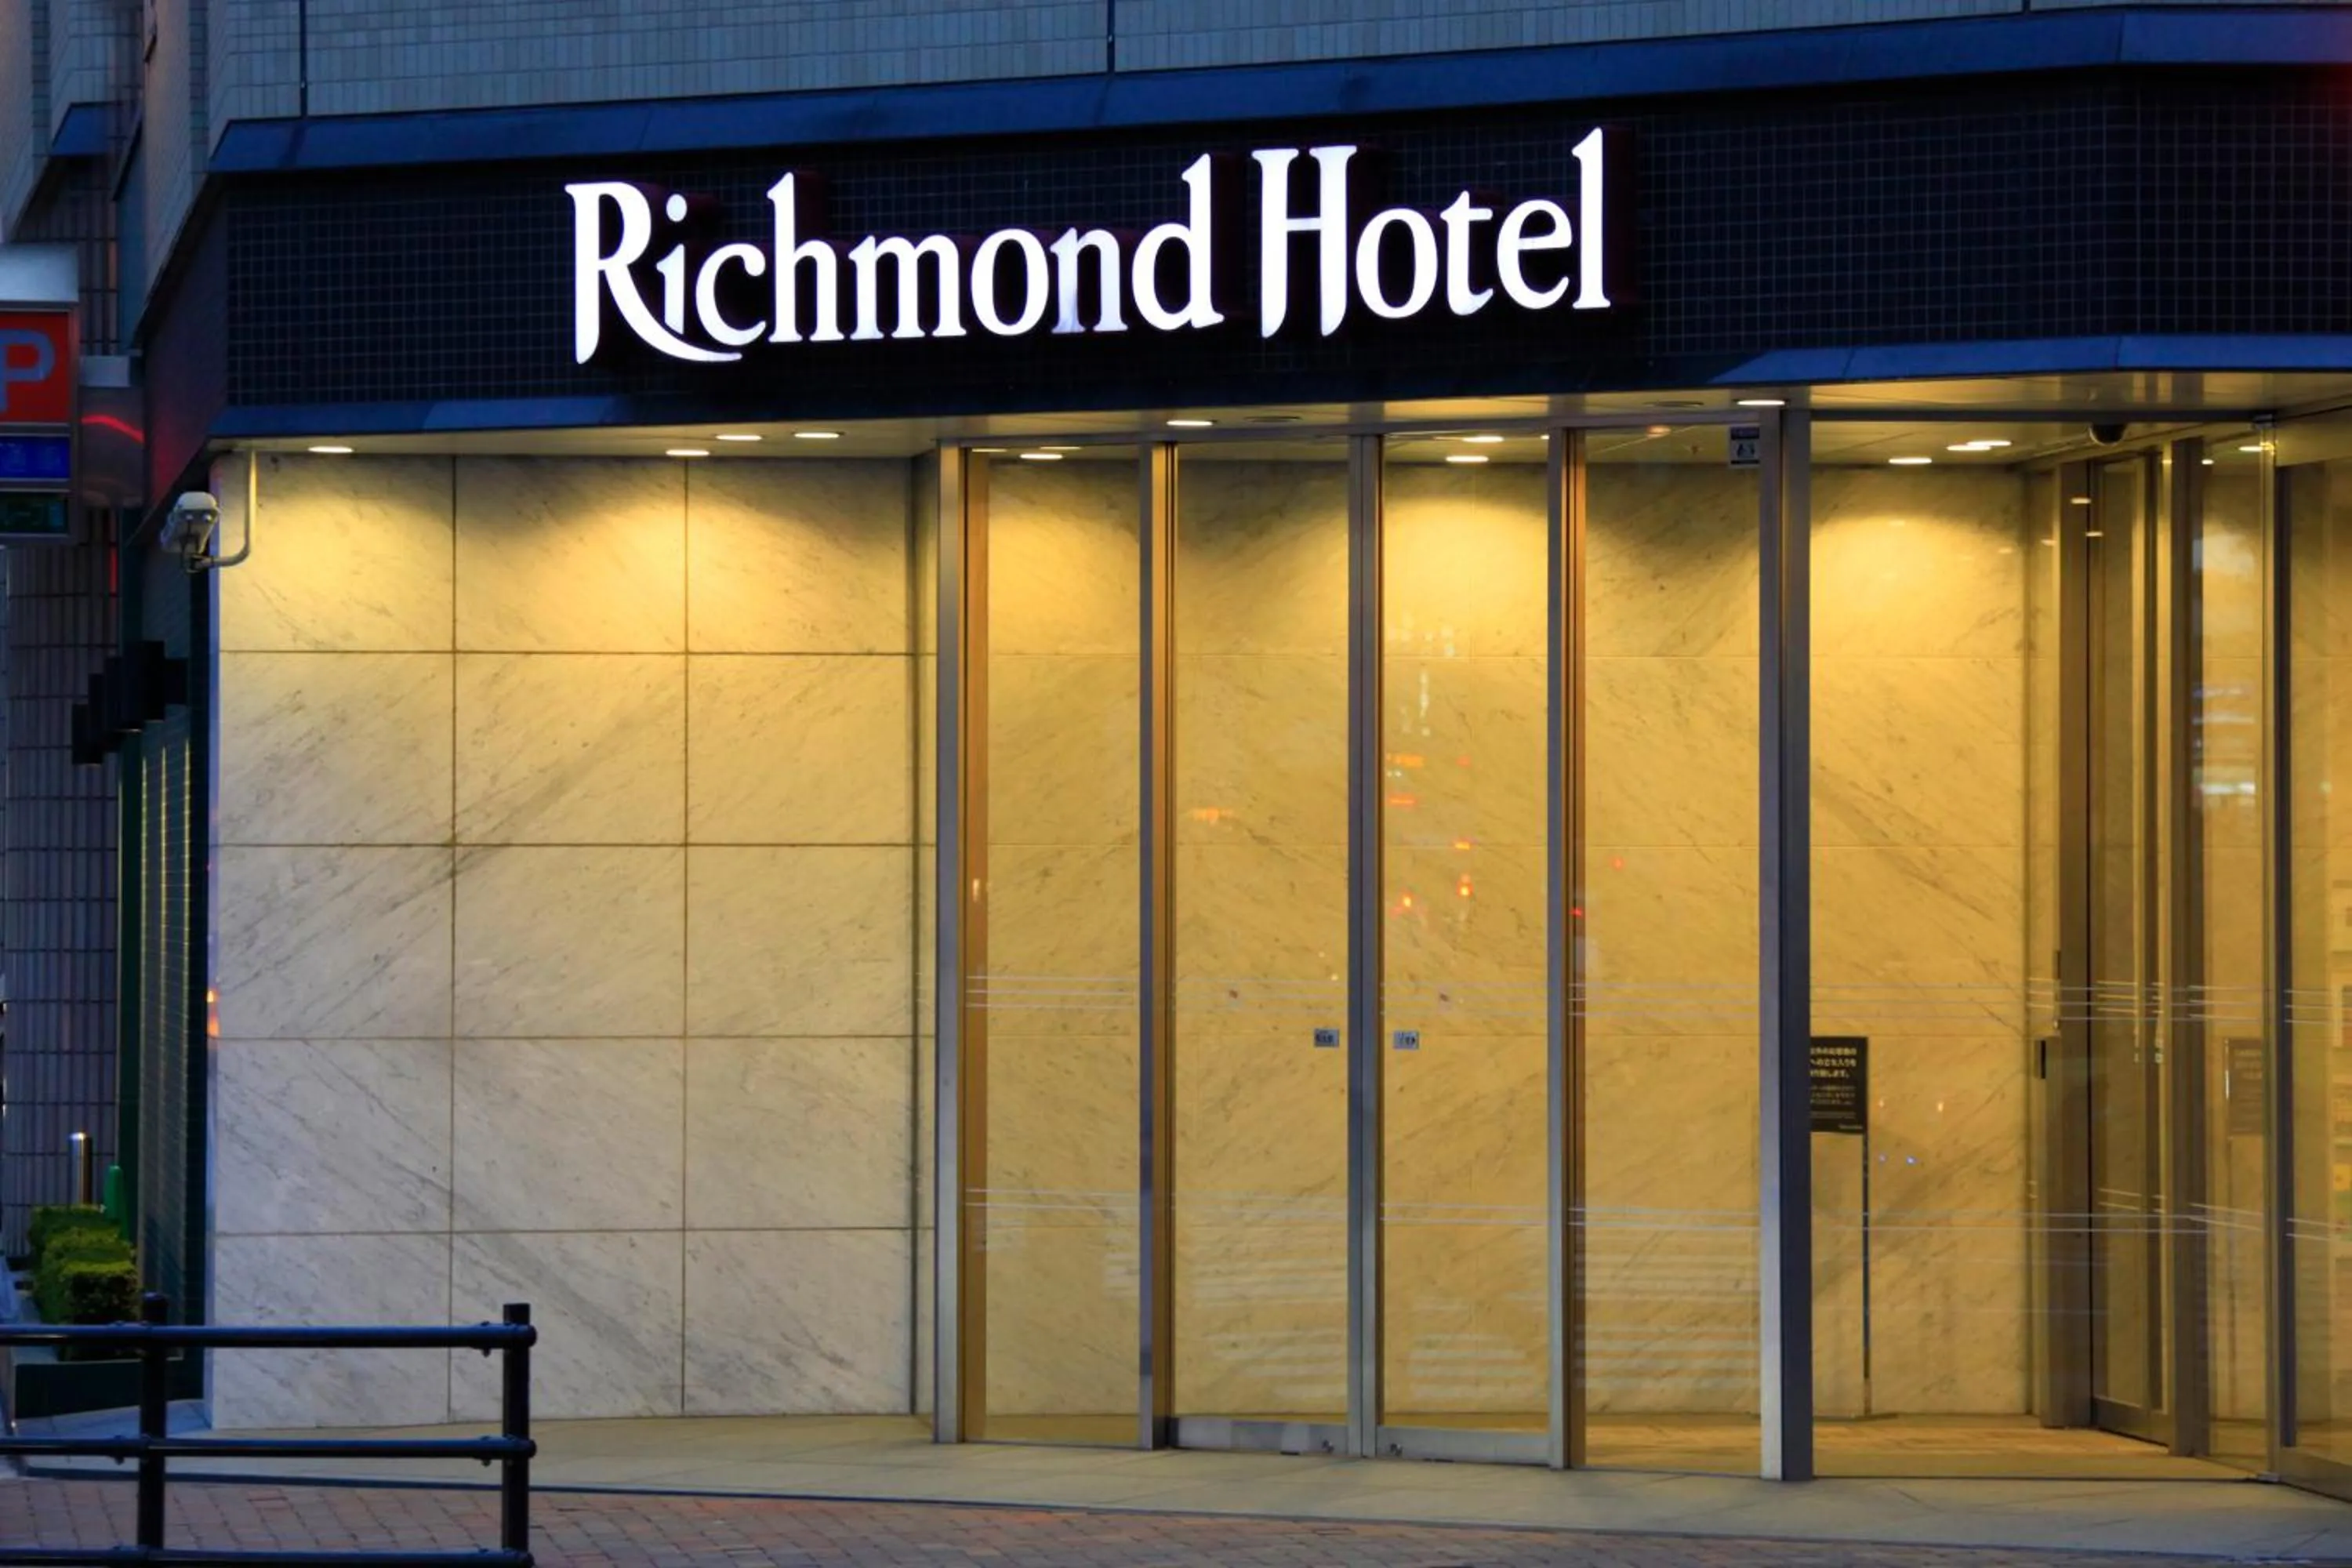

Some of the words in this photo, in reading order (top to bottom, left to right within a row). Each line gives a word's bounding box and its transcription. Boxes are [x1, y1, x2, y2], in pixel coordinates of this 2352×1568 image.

[565, 154, 1225, 364] Richmond
[1252, 128, 1611, 337] Hotel
[0, 328, 56, 413] P
